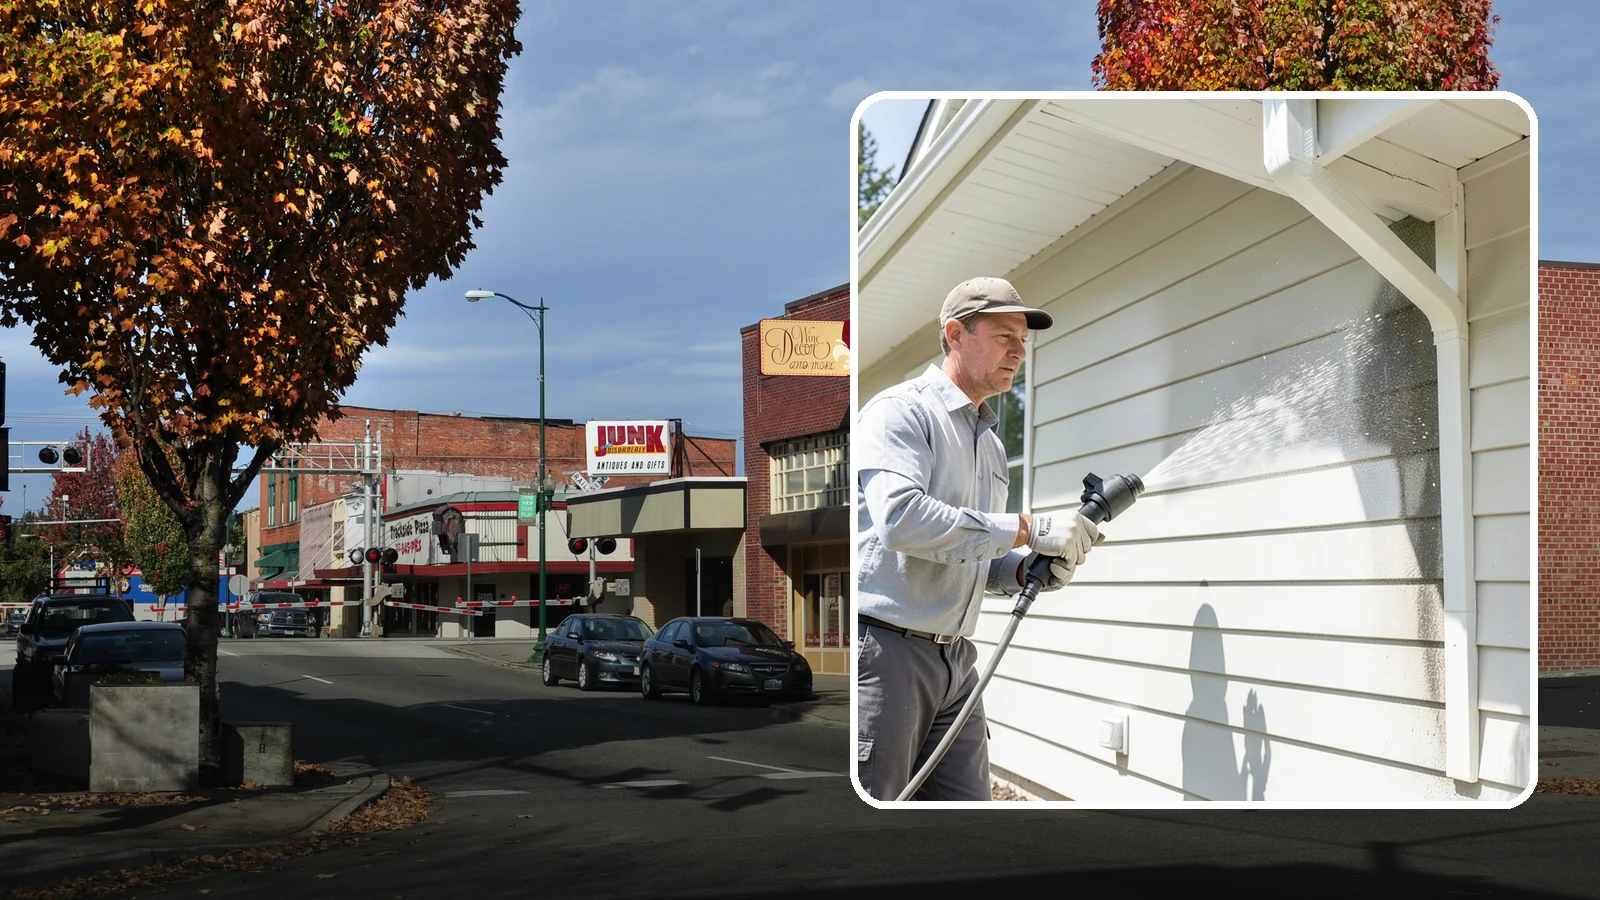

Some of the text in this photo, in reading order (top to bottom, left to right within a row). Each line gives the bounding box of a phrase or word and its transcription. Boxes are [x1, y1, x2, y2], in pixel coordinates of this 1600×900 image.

[595, 425, 664, 457] JUNK
[607, 446, 646, 454] DISORDERLY
[597, 460, 665, 470] ANTIQUES AND GIFTS
[390, 519, 429, 540] Trackside Pizza
